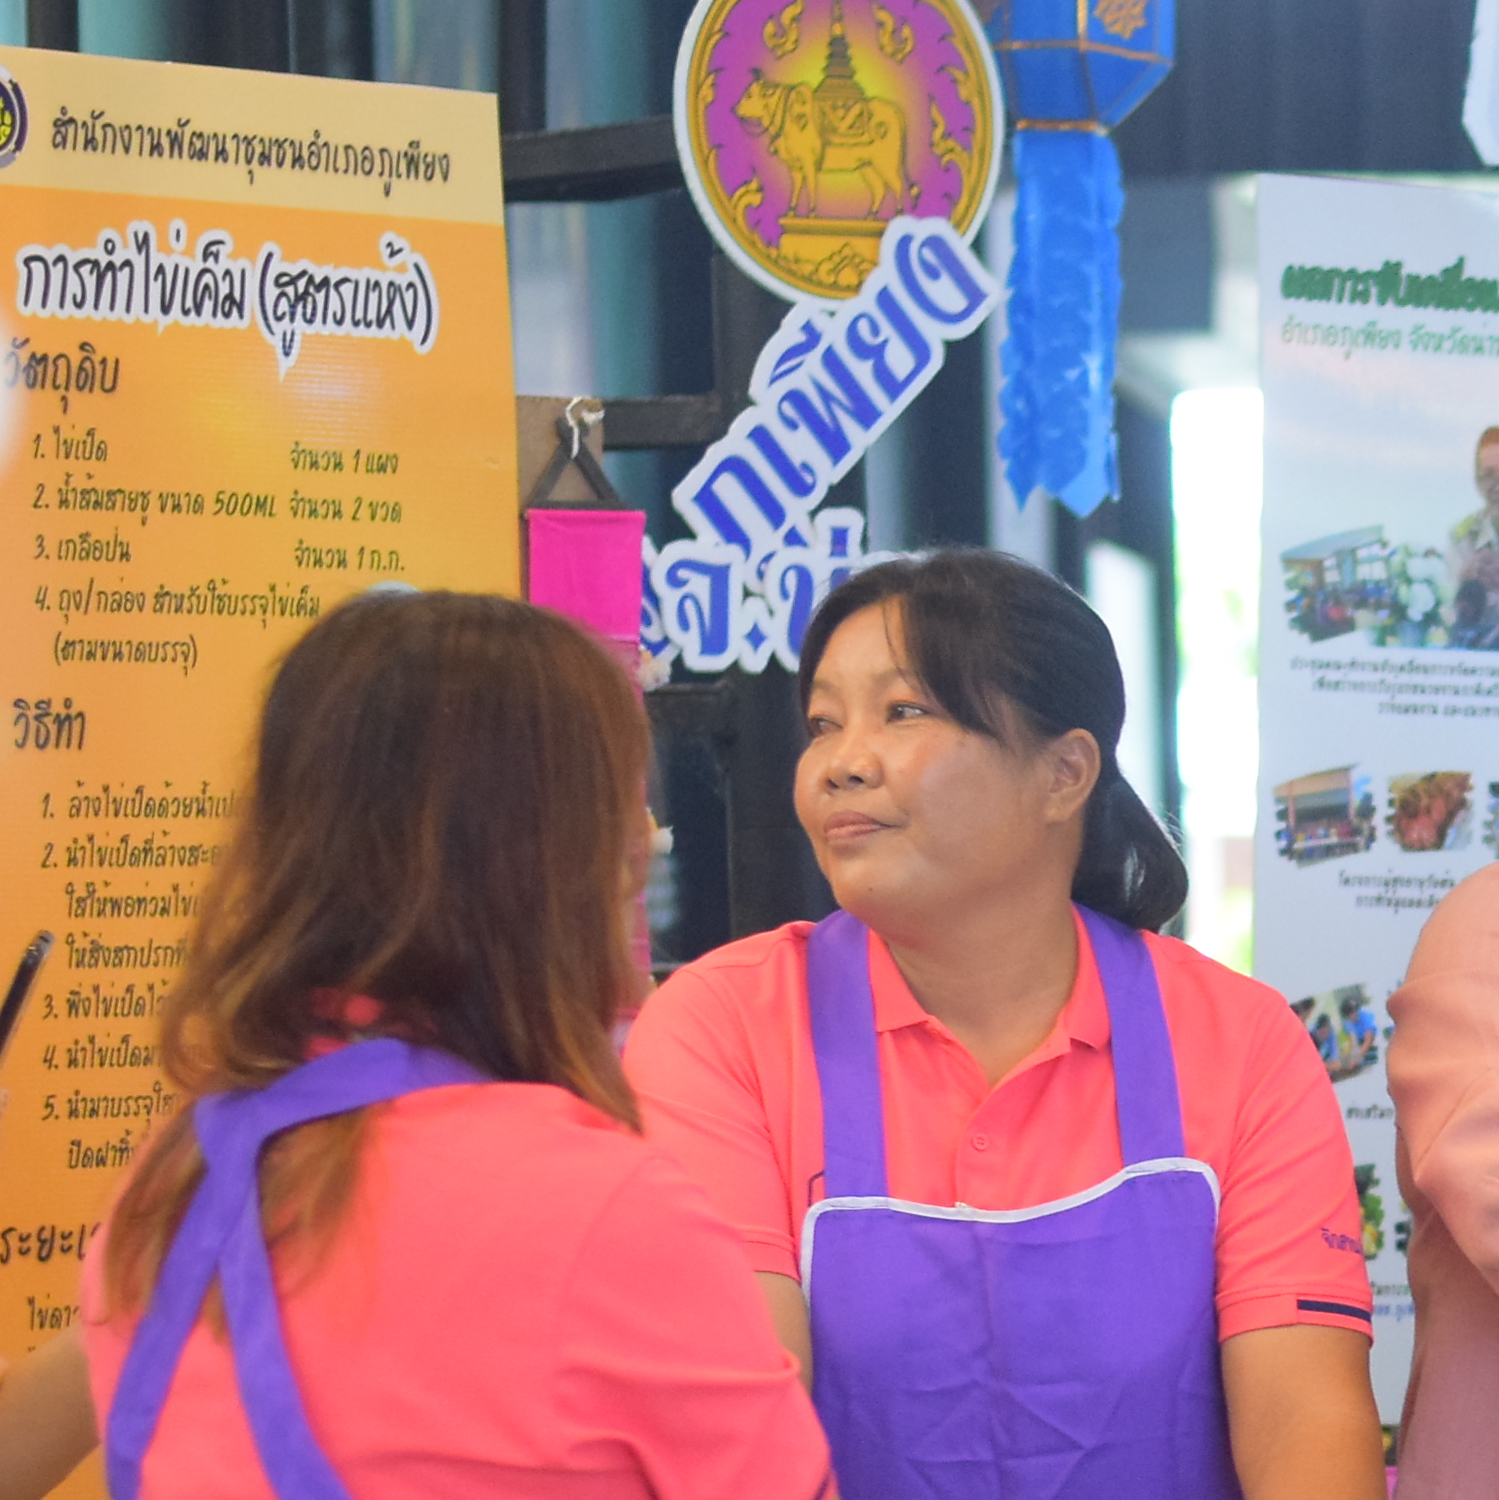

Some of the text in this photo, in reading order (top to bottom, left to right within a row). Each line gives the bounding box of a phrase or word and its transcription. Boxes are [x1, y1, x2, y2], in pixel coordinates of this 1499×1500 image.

[51, 106, 450, 197] สำนักงานพัฒนาชุมชนอำเภอภูเพียง
[22, 231, 433, 357] การทำไข่เค็ม (สูตรแห้ง)
[4, 336, 119, 415] วัตถุดิบ
[33, 424, 108, 462] 1. ไข่เป็ด
[290, 441, 399, 475] จำนวน 1 แผง
[32, 472, 402, 527] 2. น้ำส้มสายชู ขนาด 500ML จำนวน 2 ขวด
[34, 527, 132, 563] 3. เกลือป่น
[294, 539, 348, 570] จำนวน
[34, 585, 51, 612] 4.
[54, 631, 198, 676] (ตามขนาดบรรจุ)
[13, 697, 86, 751] วิธีทำ
[41, 792, 55, 819] 1.
[41, 842, 58, 869] 2.
[43, 993, 58, 1019] 3.
[43, 1044, 59, 1070] 4.
[42, 1094, 60, 1121] 5.
[68, 1129, 134, 1170] ปิดฝาทิ้
